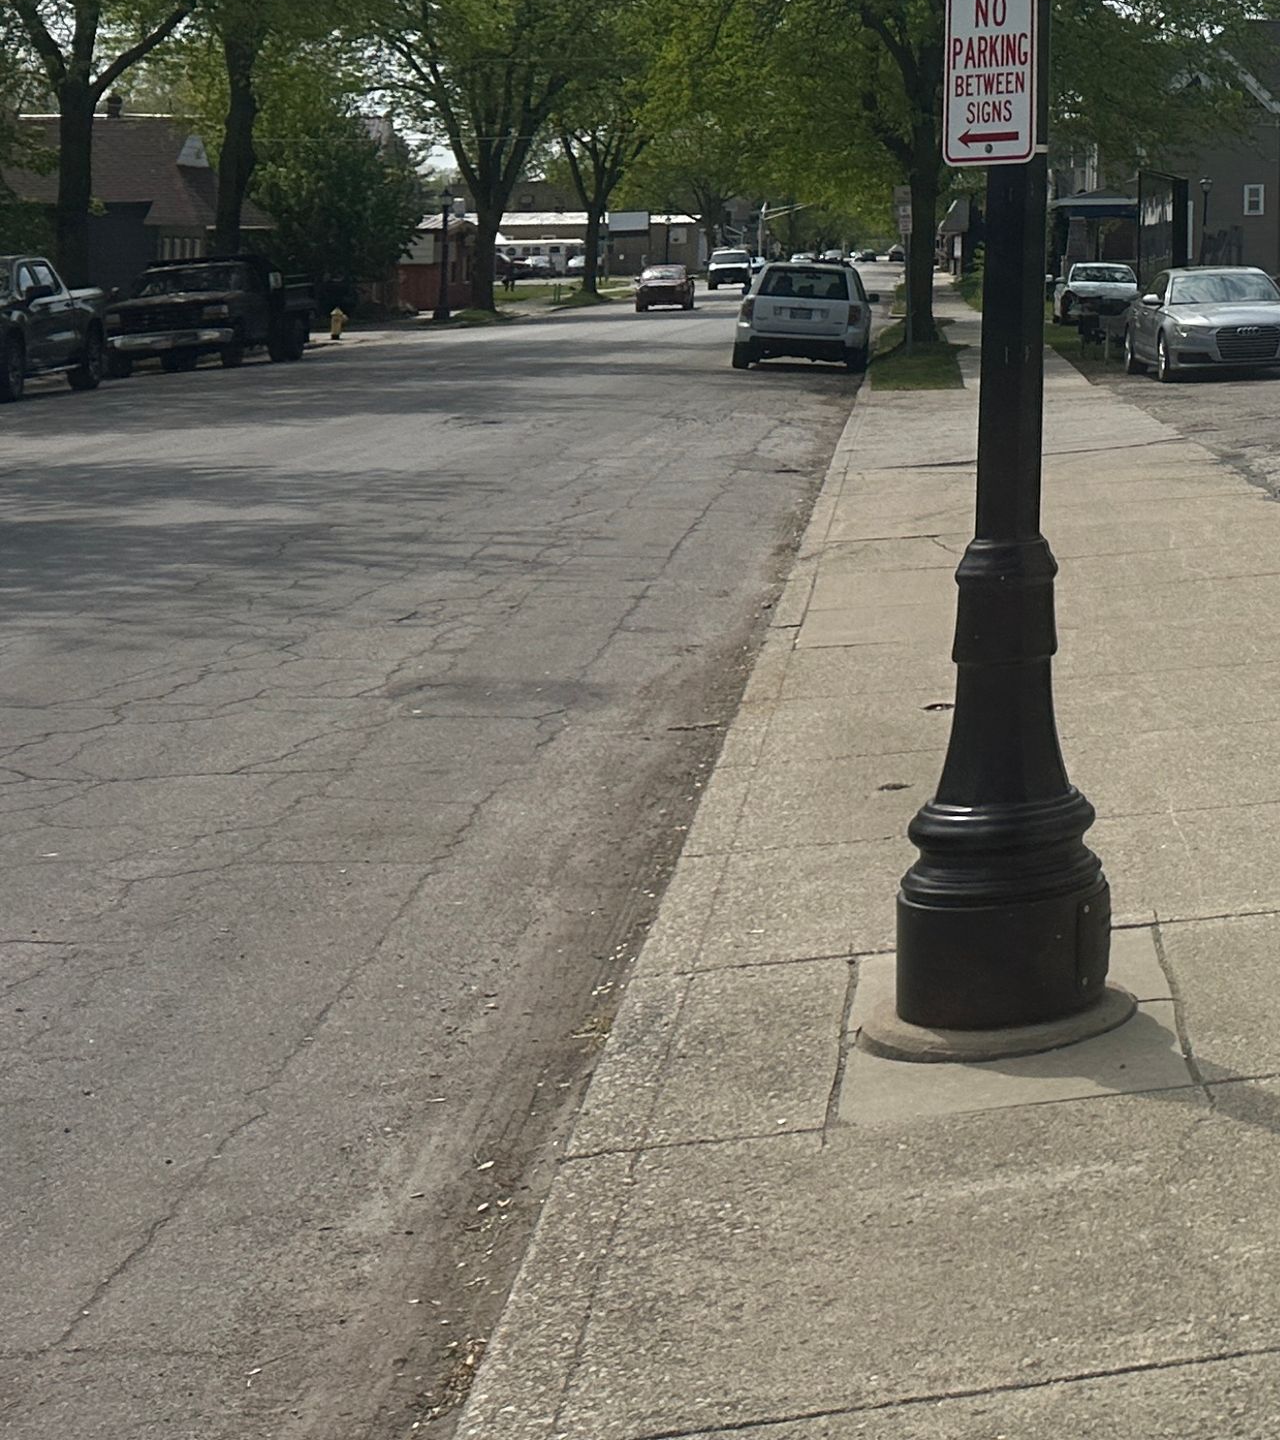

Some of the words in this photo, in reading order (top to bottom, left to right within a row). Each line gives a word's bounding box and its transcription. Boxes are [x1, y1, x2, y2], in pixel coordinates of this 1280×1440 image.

[952, 32, 1029, 70] PARKING
[954, 71, 1025, 97] BETWEEN
[966, 99, 1012, 124] SIGNS
